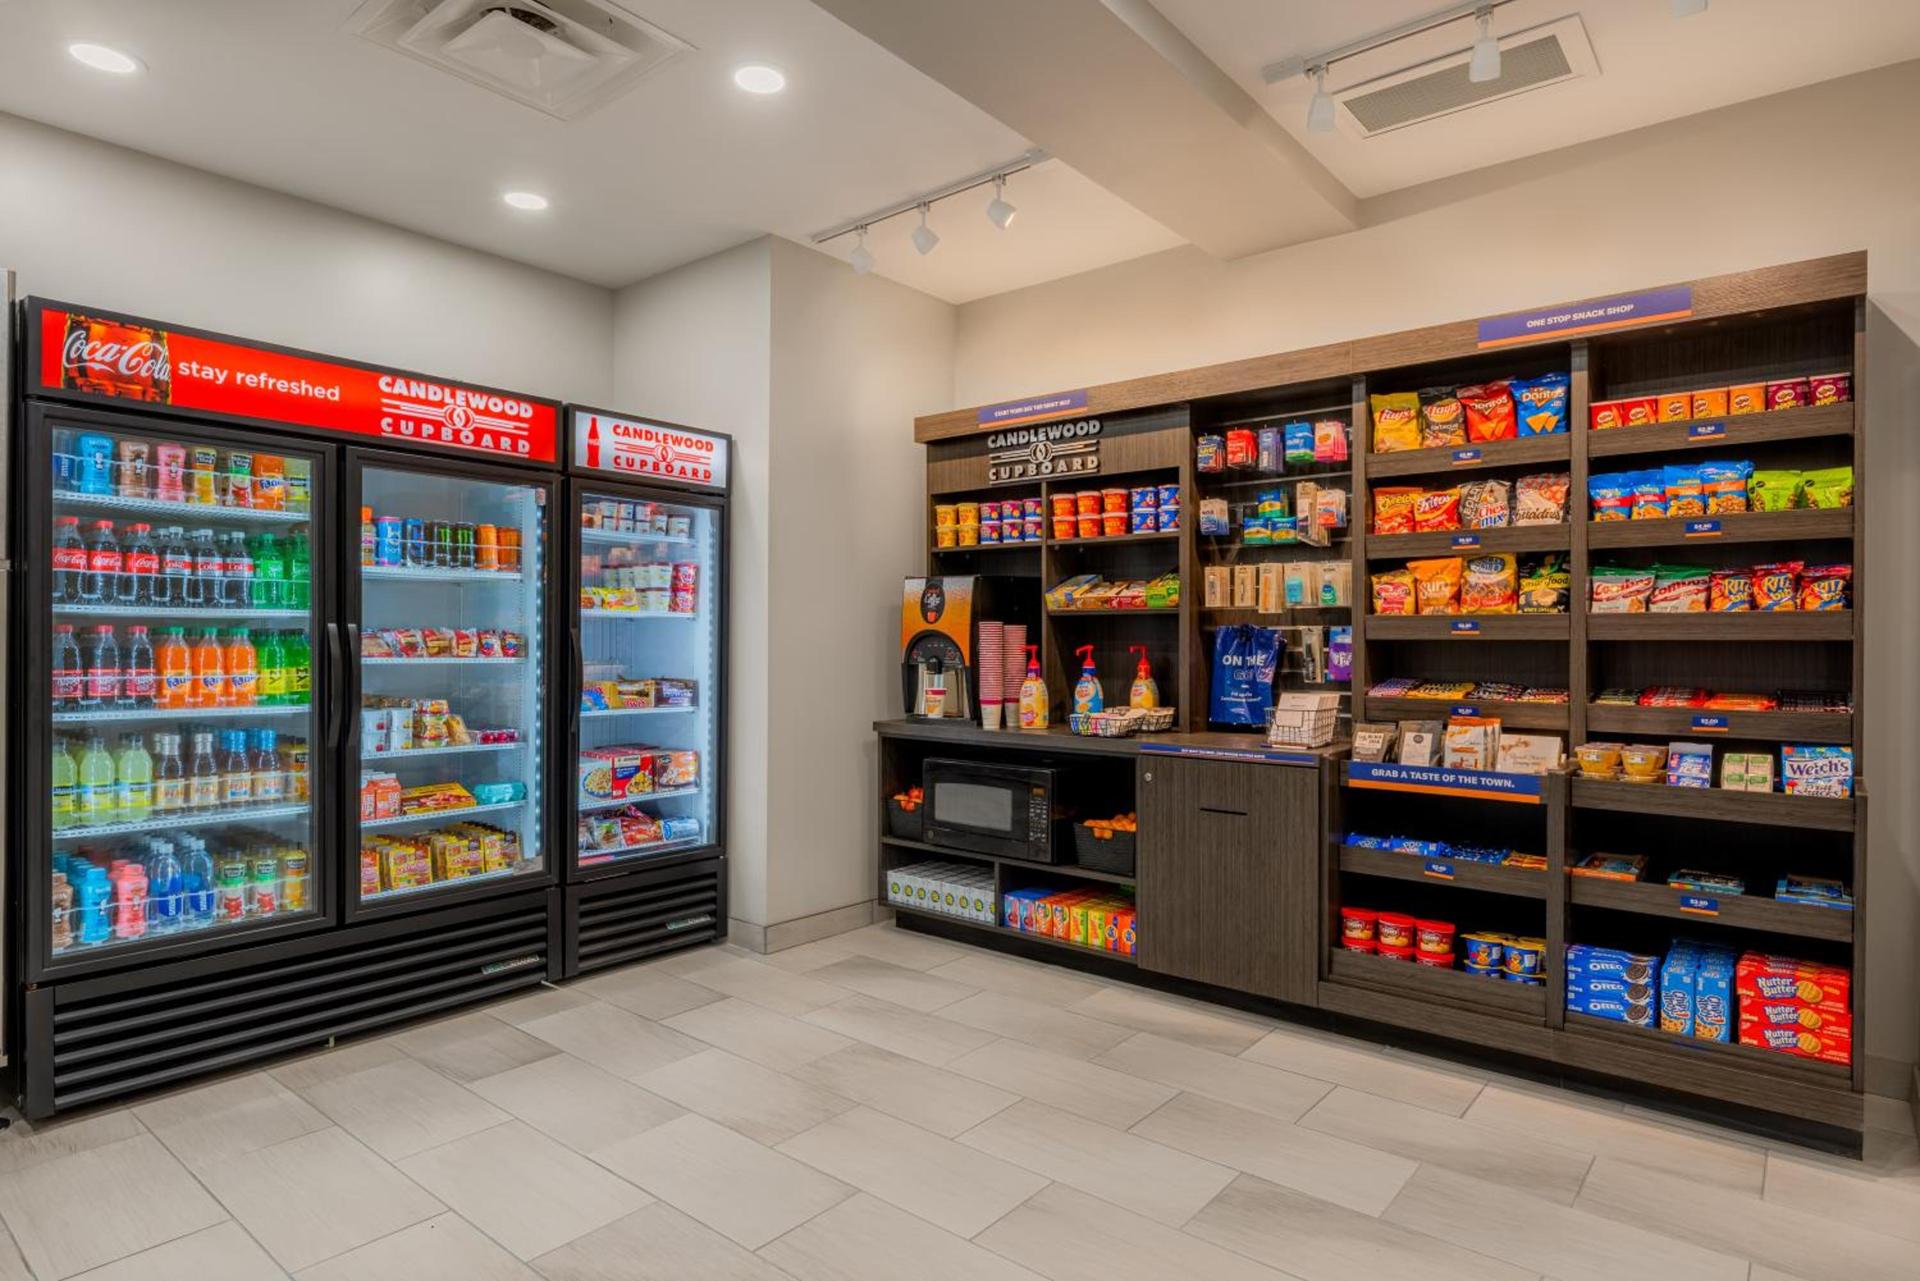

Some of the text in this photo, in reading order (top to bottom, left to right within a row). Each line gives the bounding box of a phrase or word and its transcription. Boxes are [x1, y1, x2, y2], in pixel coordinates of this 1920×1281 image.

[1526, 303, 1634, 328] ONE STOP SNACK SHOP
[63, 330, 171, 381] Coca-Cola
[178, 360, 340, 402] stay refreshed
[378, 376, 533, 419] CANDLEWOOD
[1521, 386, 1565, 402] Doritos
[380, 417, 531, 454] CUPBOARD
[613, 424, 714, 453] CANDLEWOOD
[987, 419, 1102, 450] CANDLEWOOD
[613, 455, 712, 480] CUPBOARD
[988, 455, 1099, 481] CUPBOARD
[1379, 494, 1413, 511] Cheeto
[1763, 573, 1792, 592] RITZ
[1222, 653, 1266, 667] ON THE
[1788, 760, 1849, 776] Welch's
[1371, 768, 1515, 788] GRAB A TASTE OF THE TOWN.
[1589, 962, 1623, 971] OREO
[1590, 982, 1624, 991] OREO
[1757, 976, 1793, 987] Nutter
[1763, 985, 1798, 997] Butter
[1589, 1002, 1623, 1011] OREO
[1764, 1005, 1795, 1015] Nutter
[1769, 1013, 1798, 1023] Butter
[1763, 1029, 1794, 1038] Nutter
[1769, 1036, 1798, 1046] Butter
